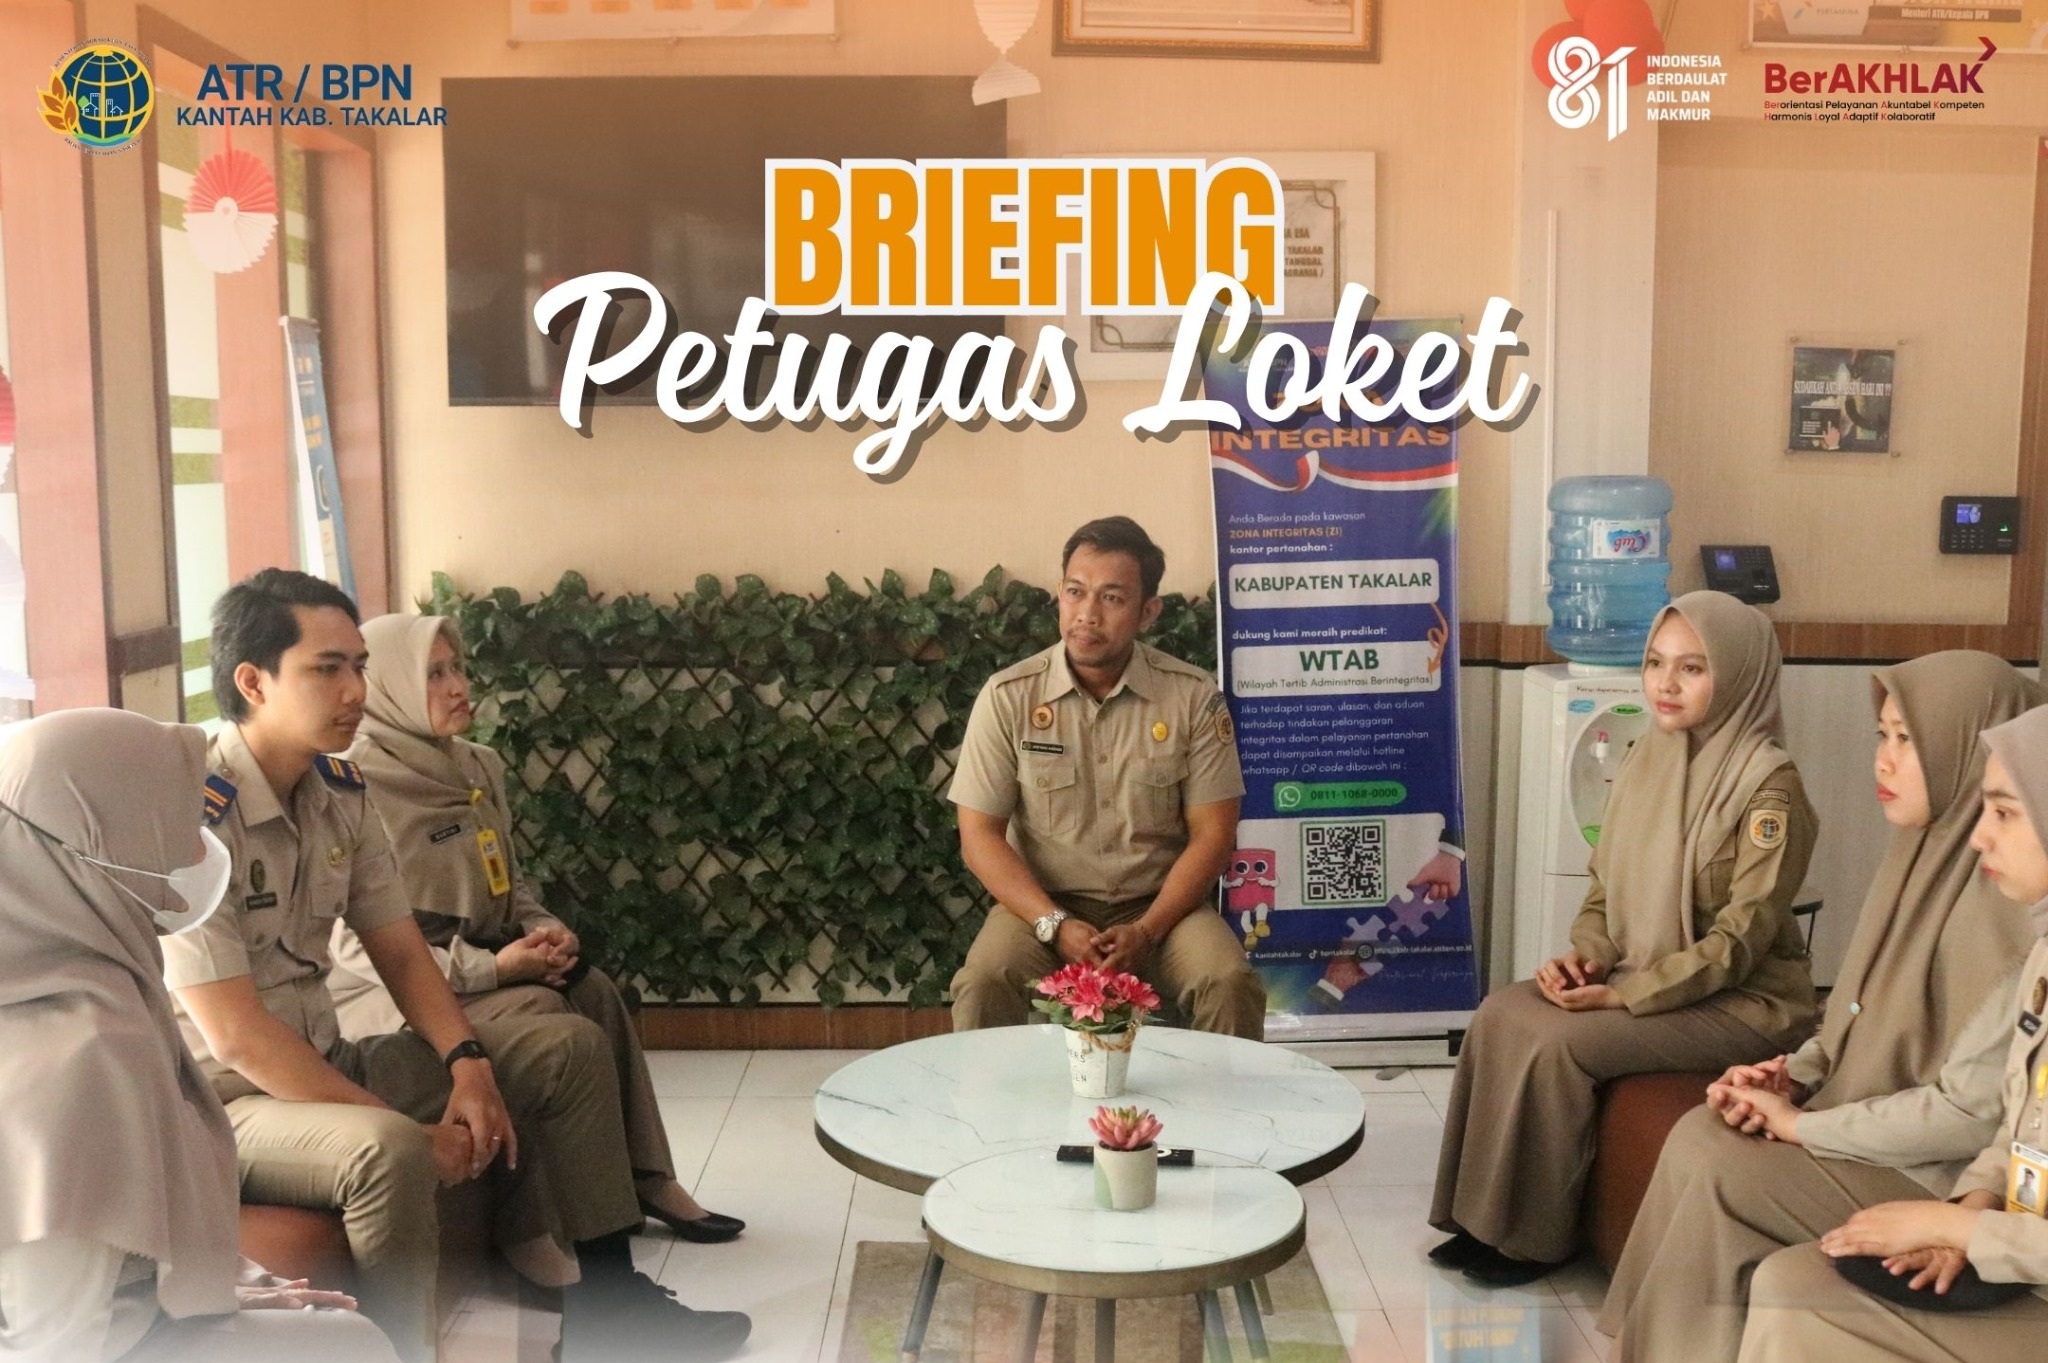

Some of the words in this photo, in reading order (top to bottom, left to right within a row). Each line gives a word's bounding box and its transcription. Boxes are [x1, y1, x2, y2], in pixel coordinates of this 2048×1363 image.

[1210, 427, 1450, 451] INTEGRITAS
[1229, 514, 1255, 524] Anda
[1257, 513, 1292, 523] Berada
[1294, 511, 1321, 524] pada
[1323, 511, 1366, 521] kawasan
[1229, 529, 1260, 539] ZONA
[1262, 527, 1324, 539] INTEGRITAS
[1325, 526, 1343, 538] (ZI)
[1229, 545, 1264, 555] kantor
[1266, 542, 1327, 556] pertanahan
[1234, 574, 1344, 593] KABUPATEN
[1348, 572, 1432, 589] TAKALAR
[1232, 630, 1271, 641] dukung
[1273, 628, 1299, 639] kami
[1301, 627, 1338, 638] meraih
[1340, 626, 1388, 639] predikat:
[1299, 648, 1380, 672] WTAB
[1236, 678, 1278, 691] (Wilayah
[1281, 678, 1308, 689] Tertib
[1310, 676, 1368, 687] Administrasi
[1370, 675, 1433, 689] Berintegritas)
[1240, 705, 1258, 715] Jika
[1261, 704, 1303, 716] terdapat
[1305, 704, 1335, 714] saran,
[1337, 701, 1371, 712] ulasan,
[1374, 701, 1393, 710] dan
[1395, 700, 1425, 709] aduan
[1240, 719, 1285, 731] terhadap
[1288, 718, 1330, 729] tindakan
[1332, 716, 1394, 730] pelanggaran
[1240, 735, 1286, 747] integritas
[1288, 734, 1319, 744] dalam
[1321, 732, 1372, 745] pelayanan
[1374, 730, 1429, 743] pertanahan
[1241, 751, 1271, 762] dapat
[1273, 749, 1334, 762] disampaikan
[1336, 747, 1371, 757] melalui
[1373, 746, 1405, 756] hotline
[1242, 765, 1290, 777] whatsapp
[1301, 763, 1317, 774] QR
[1319, 762, 1344, 773] code
[1345, 761, 1388, 773] dibawah
[1389, 761, 1402, 770] ini
